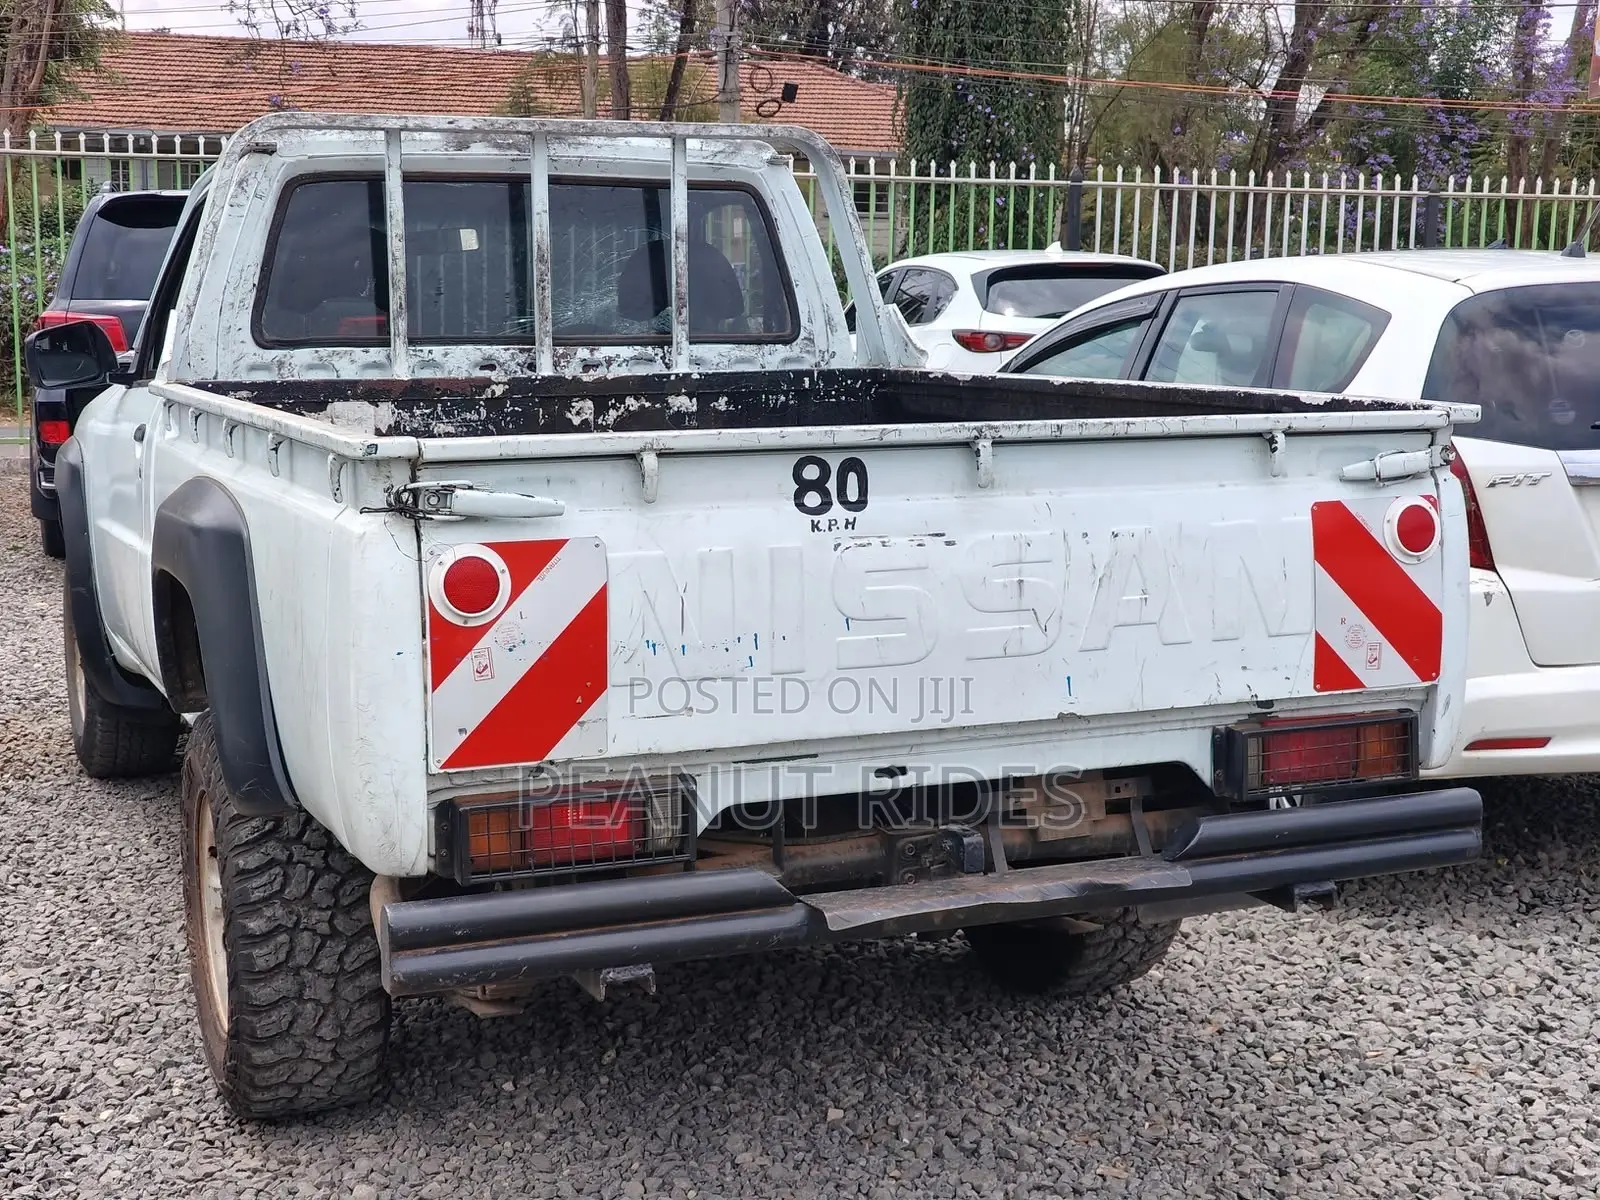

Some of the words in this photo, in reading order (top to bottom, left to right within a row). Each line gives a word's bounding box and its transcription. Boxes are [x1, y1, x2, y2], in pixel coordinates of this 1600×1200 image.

[792, 455, 869, 516] 80
[1485, 472, 1552, 488] FIT
[606, 517, 1313, 688] NISSAN
[1340, 617, 1347, 625] R
